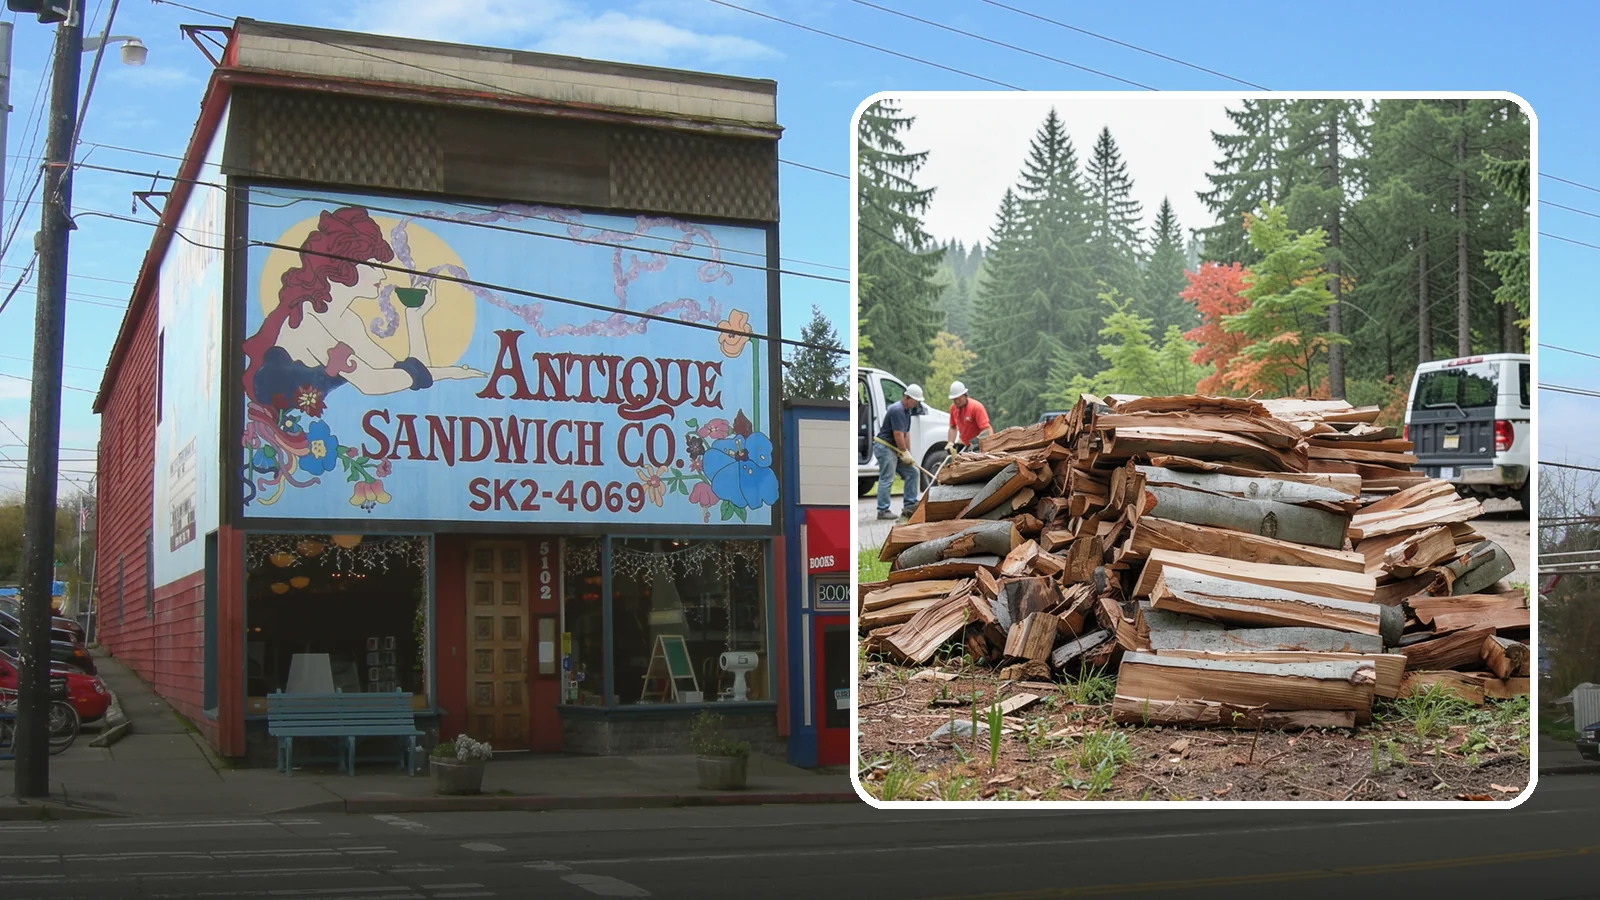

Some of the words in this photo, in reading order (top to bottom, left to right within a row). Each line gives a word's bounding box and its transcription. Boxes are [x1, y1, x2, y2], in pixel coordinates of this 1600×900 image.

[475, 329, 724, 421] ANTIQUE
[361, 408, 605, 468] SANDWICH
[616, 423, 686, 469] CO.
[468, 476, 646, 513] SK2-4069
[539, 541, 552, 600] 5102
[809, 554, 835, 569] BOOKS
